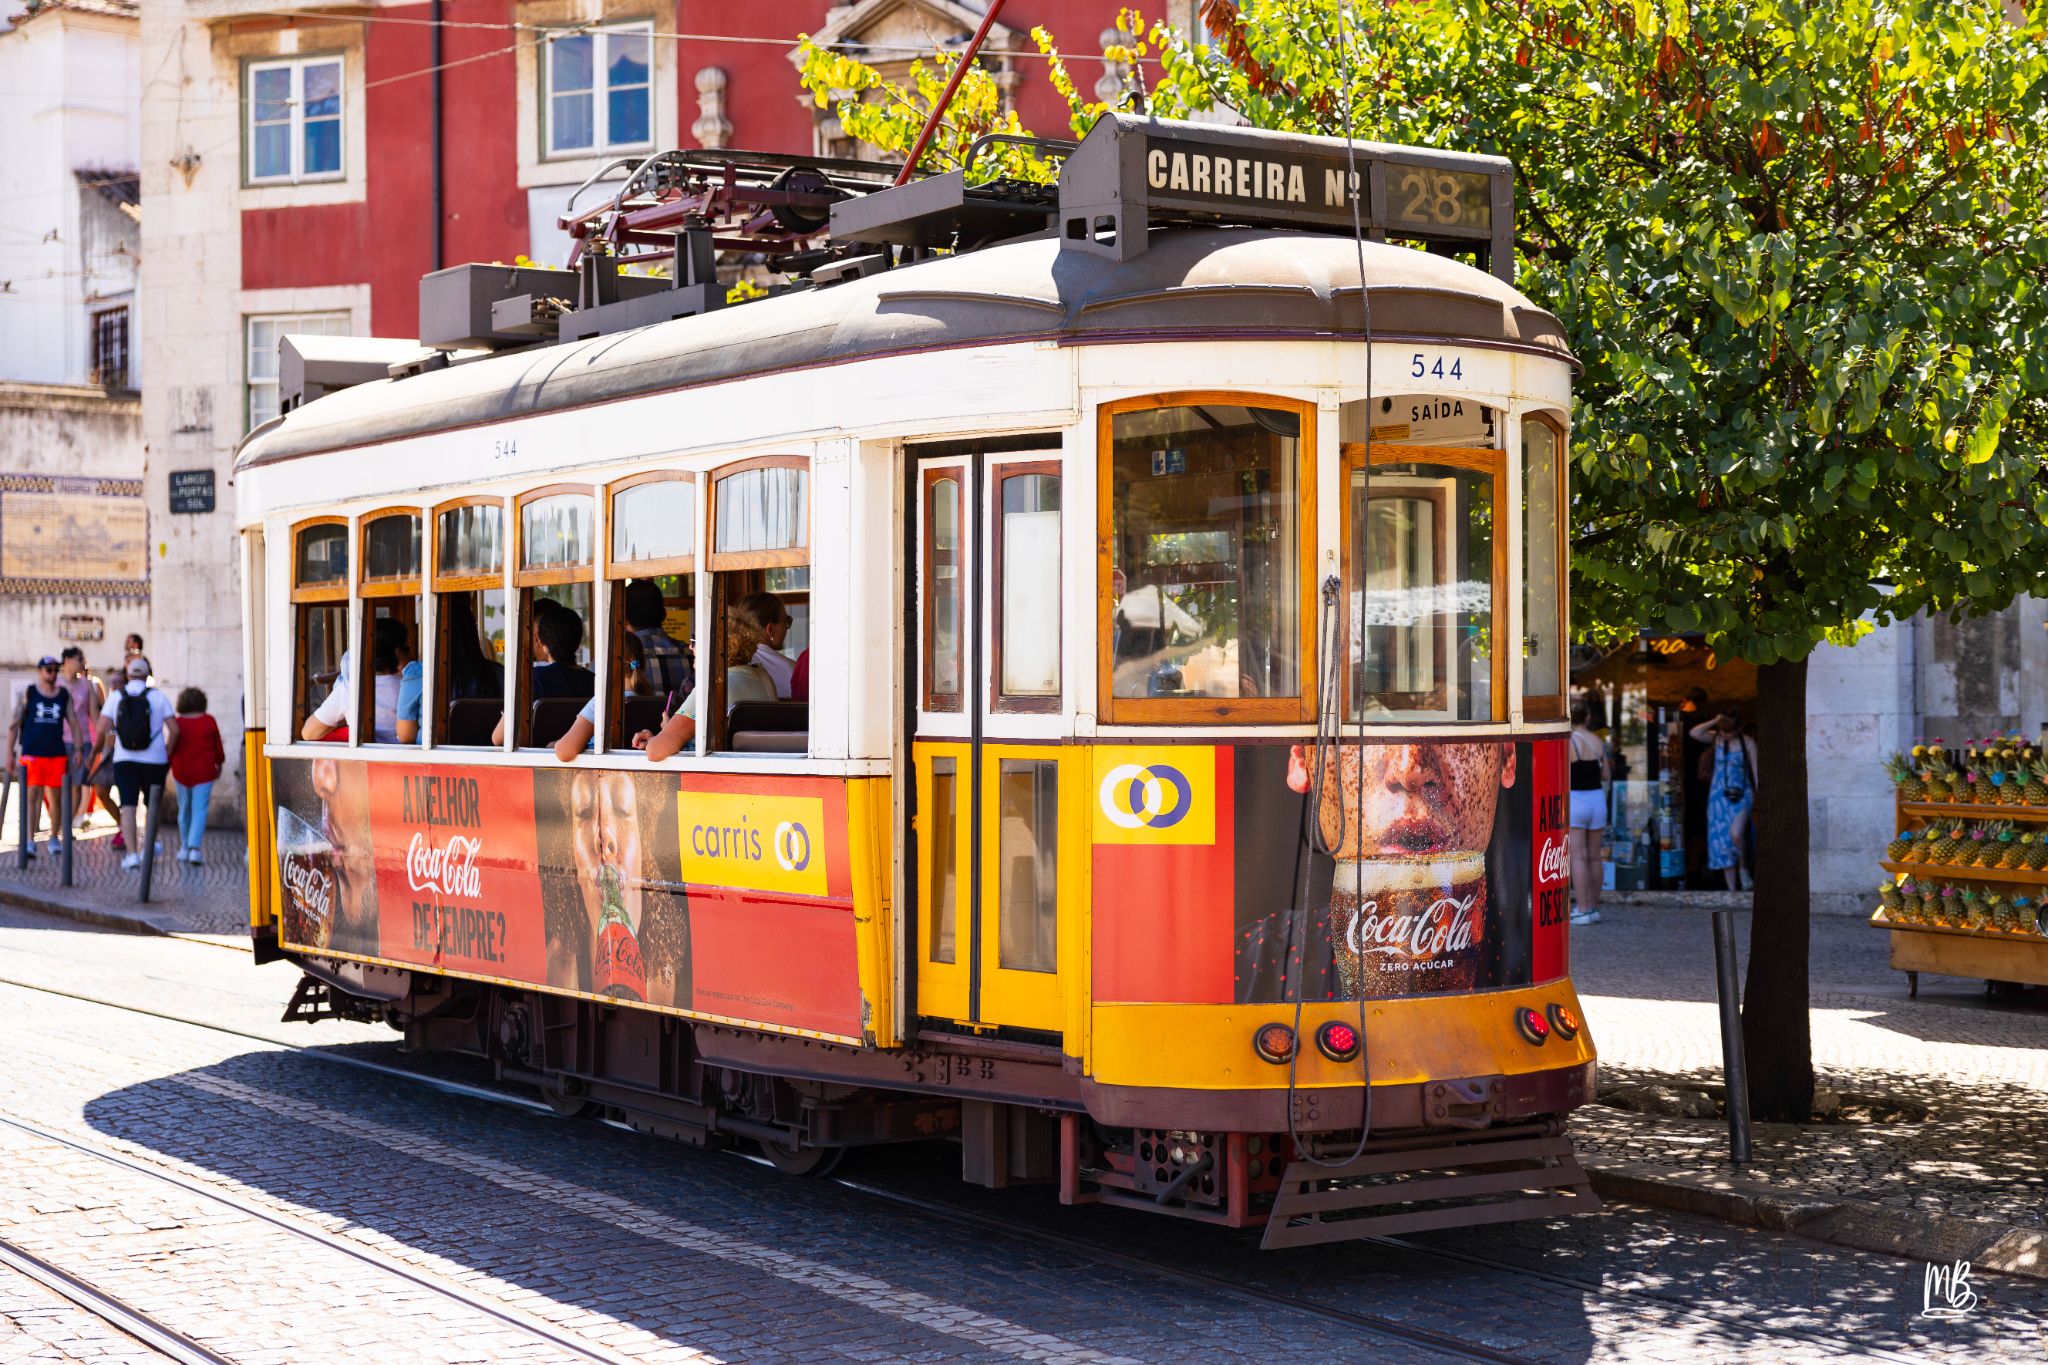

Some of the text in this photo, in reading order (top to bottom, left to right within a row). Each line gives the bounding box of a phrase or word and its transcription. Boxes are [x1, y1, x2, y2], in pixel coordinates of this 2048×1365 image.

[1147, 148, 1307, 204] CARREIRA
[1400, 173, 1462, 225] 28
[1411, 353, 1463, 381] 544
[1411, 397, 1464, 423] SAÍDA
[494, 439, 517, 459] 544
[175, 474, 208, 486] LARGO
[178, 486, 213, 498] PORTAS
[186, 497, 206, 510] SOL
[403, 775, 482, 829] A MELHOR
[1539, 795, 1547, 832] A
[691, 813, 762, 862] carris
[283, 850, 333, 917] Coca-Cola
[406, 841, 483, 899] Coca-Cola
[1346, 893, 1478, 957] Coca-Cola
[1540, 889, 1553, 928] DE
[412, 901, 507, 963] DE SEMPRE?
[1380, 959, 1454, 973] ZERO AÇÚCAR
